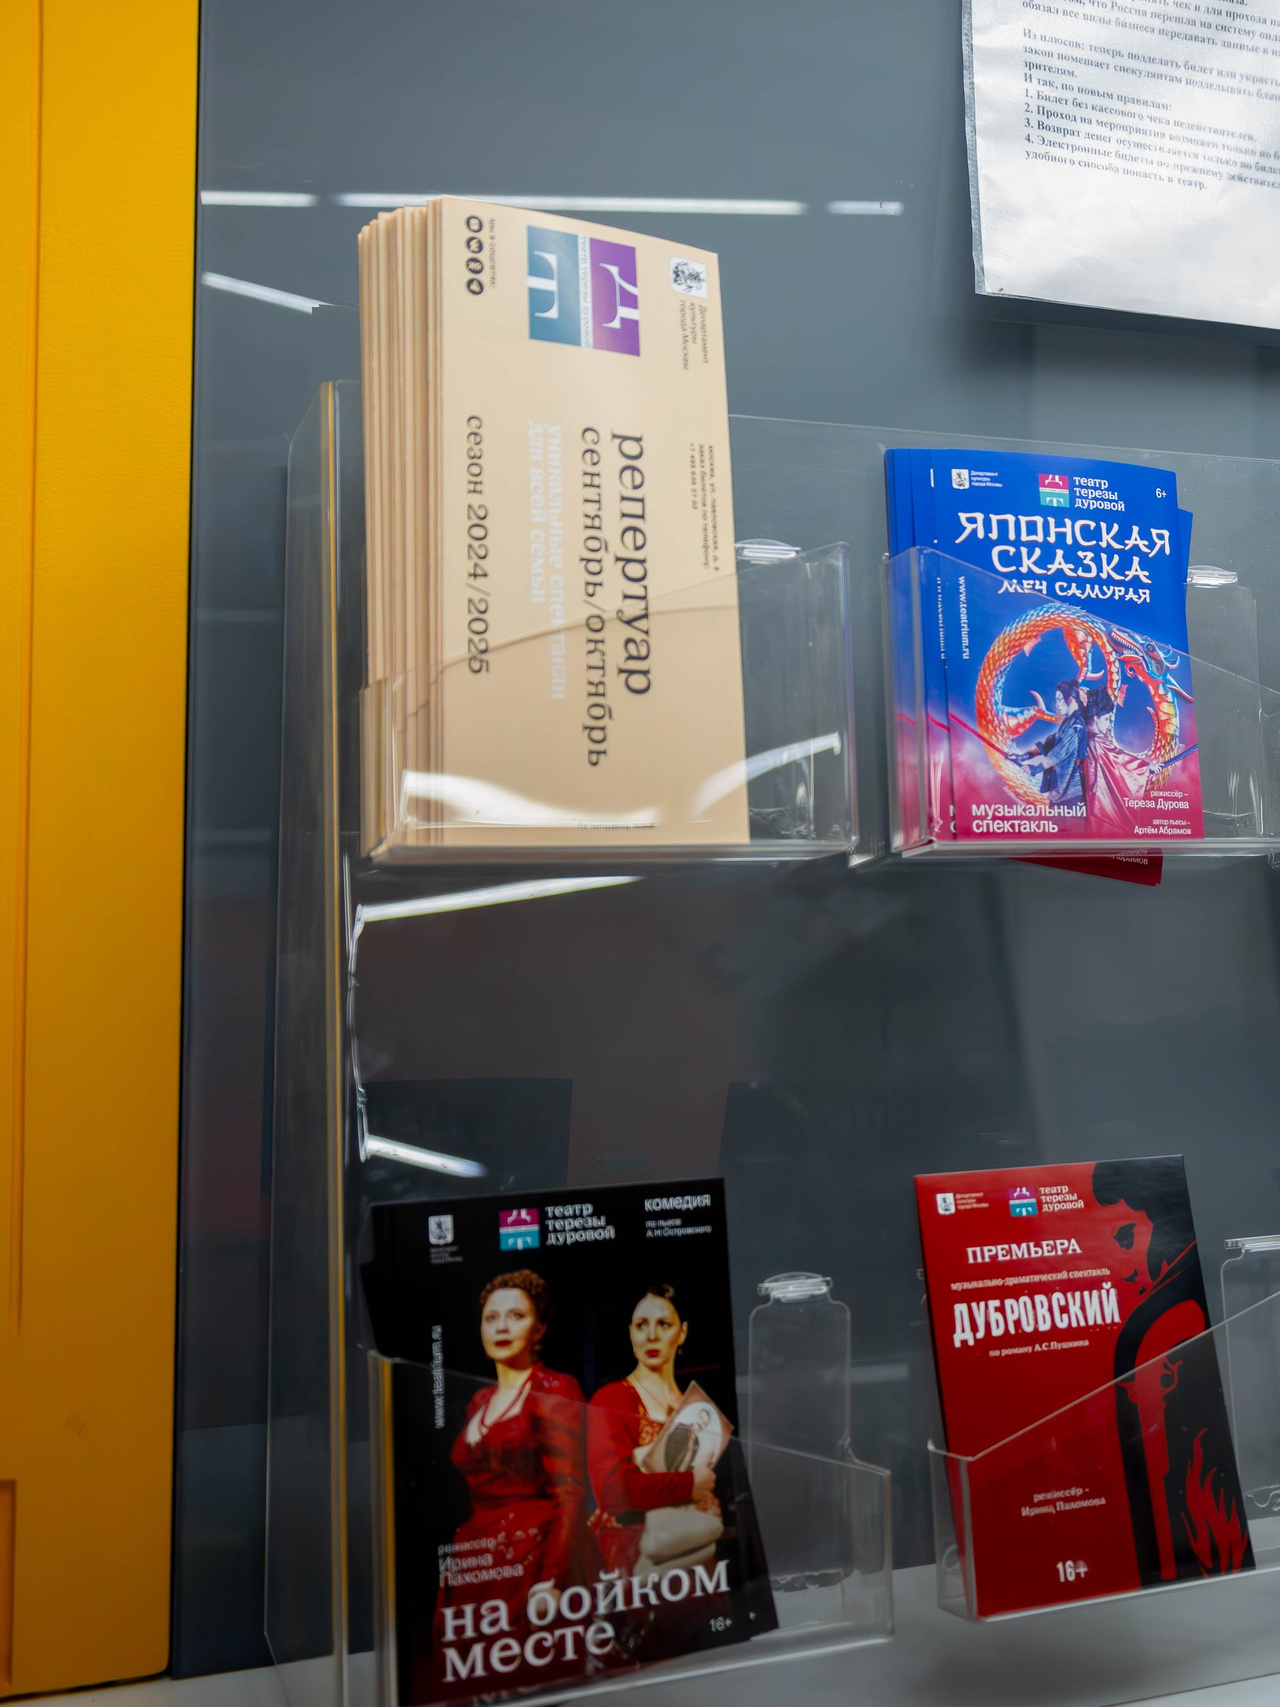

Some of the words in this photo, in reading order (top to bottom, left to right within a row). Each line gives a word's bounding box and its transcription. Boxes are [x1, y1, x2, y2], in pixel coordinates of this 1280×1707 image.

[1023, 59, 1078, 78] зрителям.
[1036, 76, 1058, 89] так,
[1077, 84, 1113, 100] новым
[1116, 92, 1172, 112] правилам:
[1036, 90, 1069, 106] Билет
[1072, 97, 1088, 110] без
[1091, 102, 1144, 120] кассового
[1146, 114, 1170, 126] чека
[1036, 105, 1077, 122] Проход
[1095, 118, 1166, 140] мероприятия
[1037, 120, 1081, 138] Возврат
[1084, 130, 1112, 144] денег
[466, 415, 487, 495] сезон
[528, 421, 544, 469] для
[1073, 475, 1109, 490] театр
[1074, 487, 1118, 501] терезы
[1156, 487, 1167, 499] 6+
[529, 474, 545, 522] всей
[545, 424, 565, 571] уникальные
[1074, 498, 1125, 512] дуровой
[955, 512, 1171, 557] ЯПОНСКАЯ
[530, 528, 547, 603] семьи
[610, 432, 653, 697] репертуар
[991, 545, 1152, 584] СКАЗКА
[467, 504, 490, 675] 2024/2025
[580, 427, 614, 767] сентябрь/октябрь
[998, 579, 1047, 595] МЕЧ
[1055, 581, 1150, 604] САМУРАЯ
[958, 575, 970, 660] www.teatrium.ru
[550, 574, 567, 699] спектакли
[1124, 797, 1155, 808] Тереза
[1157, 799, 1190, 811] Дурова
[1150, 790, 1183, 799] режиссёр
[972, 802, 1087, 819] музыкальный
[972, 819, 1058, 834] спектакль
[1134, 825, 1158, 835] Артём
[1159, 826, 1191, 836] Абрамов
[1040, 1185, 1069, 1195] театр
[1041, 1192, 1078, 1204] терезы
[546, 1203, 594, 1219] театр
[644, 1194, 711, 1213] комедия
[1042, 1200, 1084, 1212] дуровой
[546, 1215, 606, 1232] терезы
[546, 1226, 615, 1246] дуровой
[967, 1238, 1082, 1264] ПРЕМЬЕРА
[950, 1269, 1067, 1291] музыкально-драматический
[1069, 1267, 1110, 1281] спектакль
[953, 1282, 1121, 1348] ДУБРОВСКИЙ
[1001, 1344, 1032, 1358] роману
[438, 1553, 493, 1573] Ирина
[439, 1562, 524, 1588] Пахомова
[1056, 1559, 1089, 1583] 16+
[440, 1597, 511, 1642] на
[526, 1559, 731, 1628] бойком
[441, 1621, 616, 1683] месте
